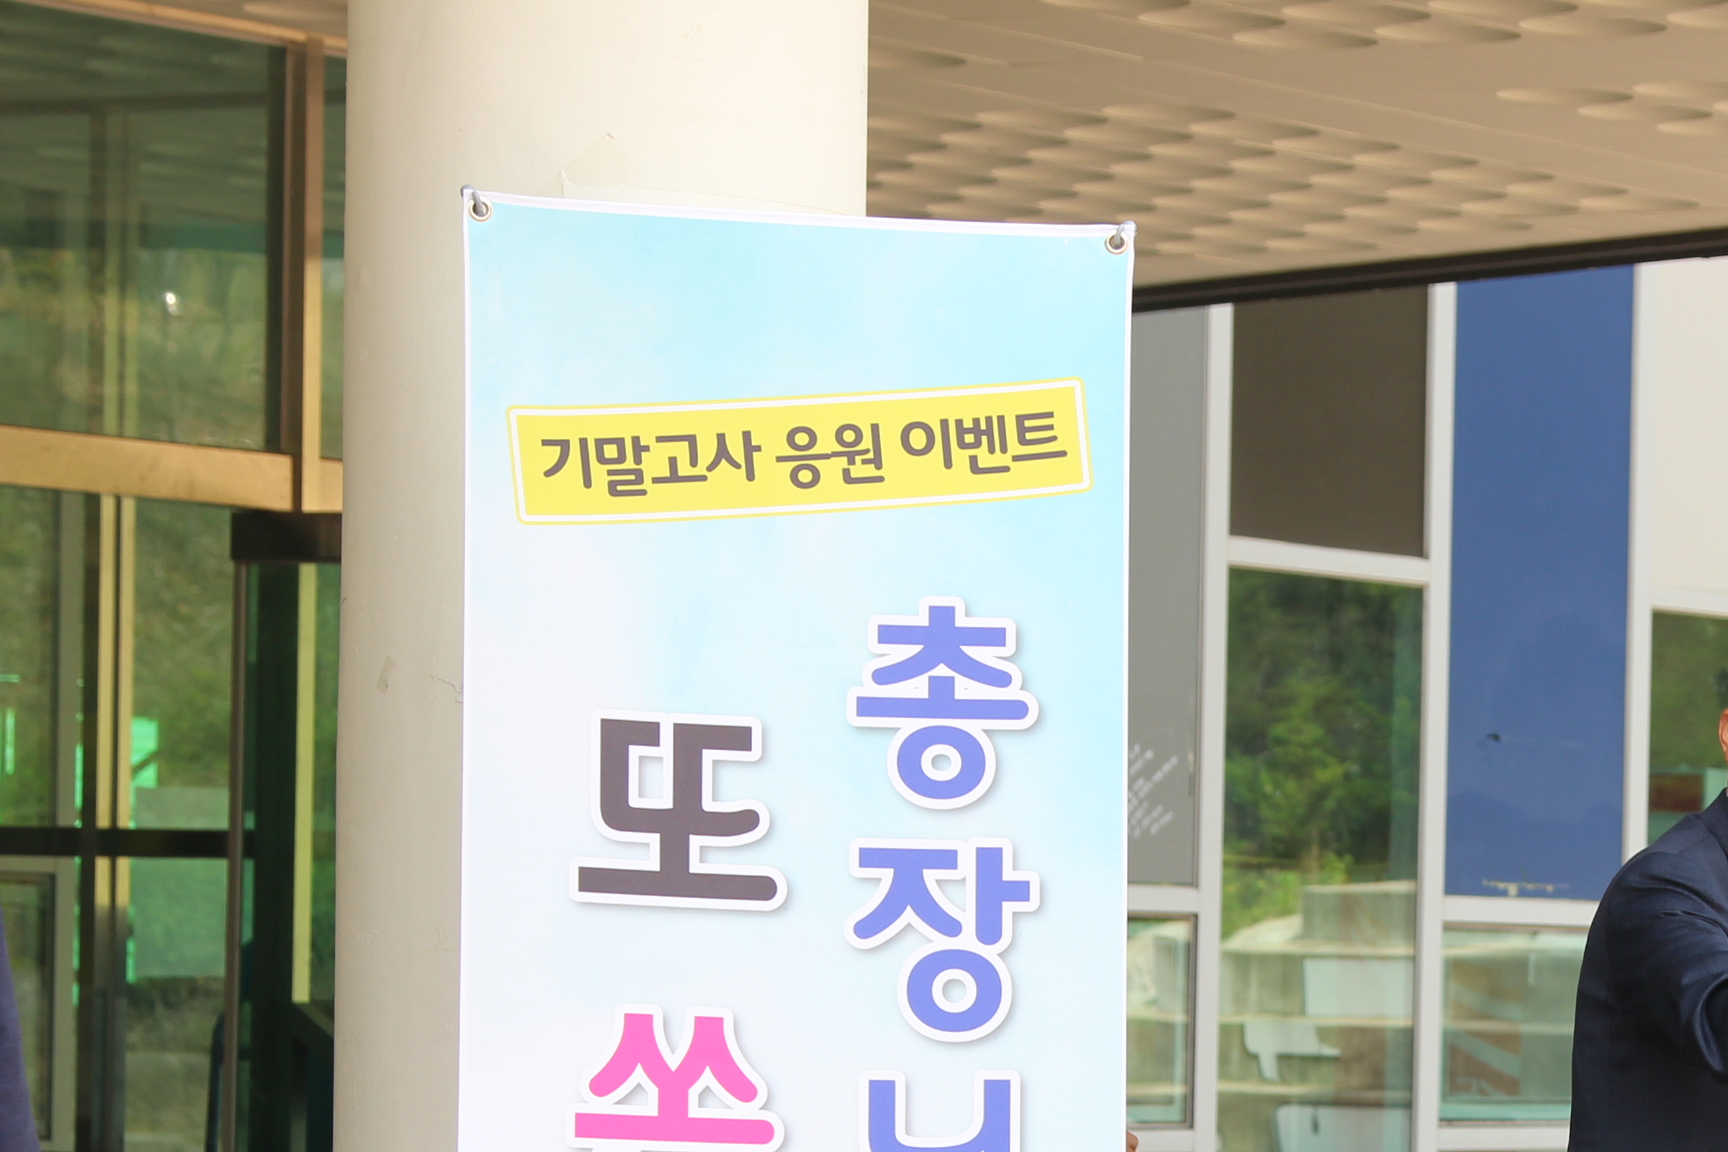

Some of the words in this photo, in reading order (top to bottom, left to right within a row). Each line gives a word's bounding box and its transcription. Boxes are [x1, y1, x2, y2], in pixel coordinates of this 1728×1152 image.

[540, 430, 761, 497] 기말고사
[775, 422, 885, 489] 응원
[899, 411, 1067, 474] 이벤트
[578, 717, 778, 901] 또
